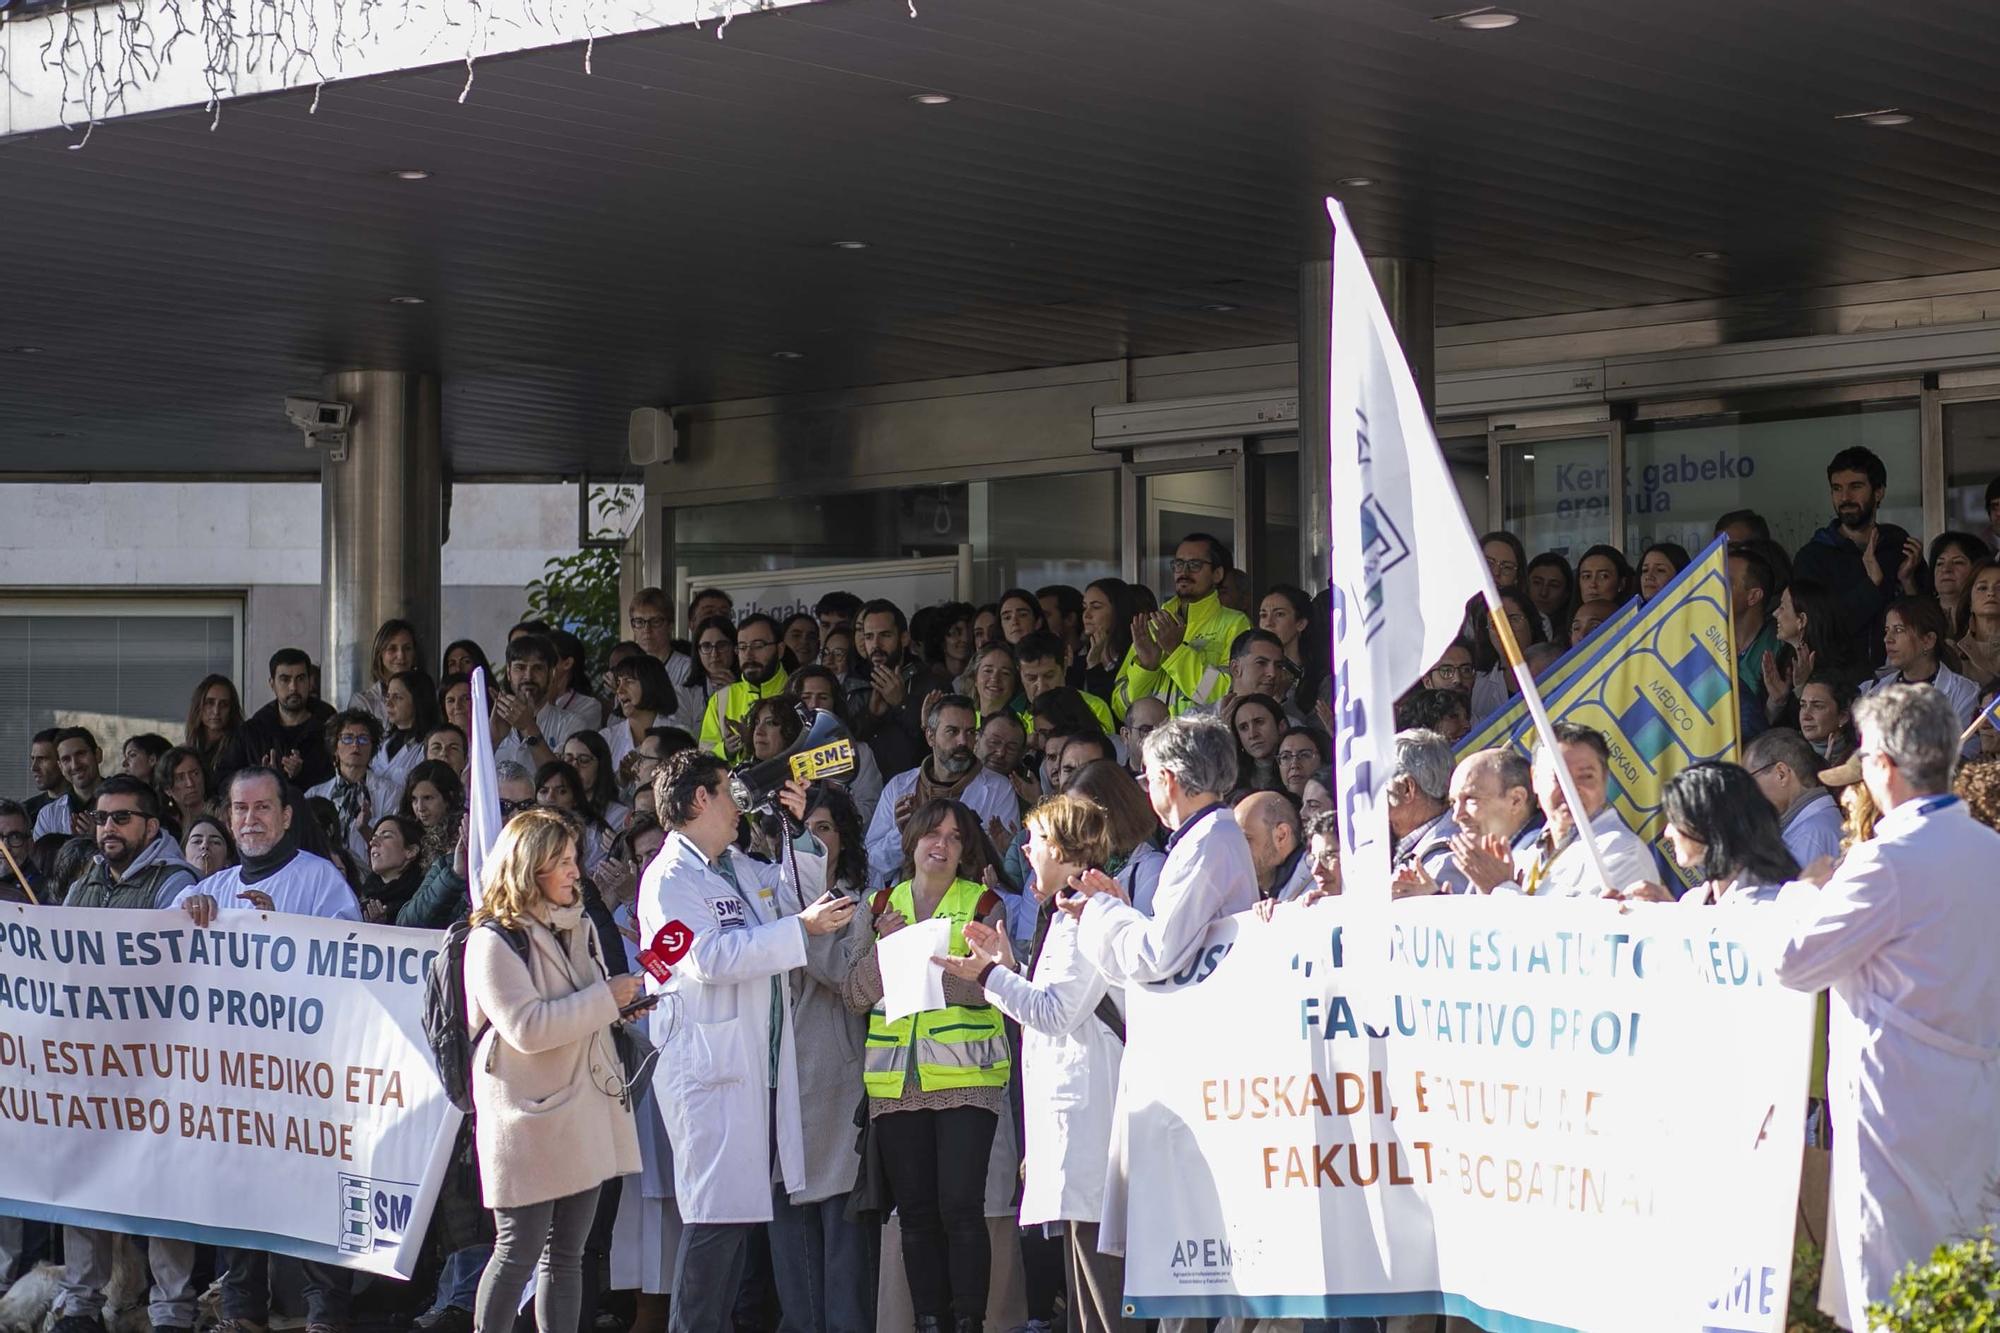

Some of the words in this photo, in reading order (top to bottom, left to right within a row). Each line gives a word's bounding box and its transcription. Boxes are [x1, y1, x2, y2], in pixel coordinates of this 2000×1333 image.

[1643, 450, 1755, 492] gabeko
[1648, 680, 1693, 731] MEDICO
[814, 744, 850, 766] SME
[716, 900, 743, 916] SME
[51, 929, 105, 965] UN
[116, 929, 296, 972] ESTATUTO
[208, 987, 324, 1035] PROPIO
[0, 1031, 36, 1076] DI,
[42, 1038, 210, 1083] ESTATUTU
[220, 1050, 334, 1100] MEDIKO
[346, 1066, 405, 1108] ETA
[1202, 1070, 1398, 1122] EUSKADI,
[180, 1102, 276, 1149] BATEN
[285, 1115, 353, 1162] ALDE
